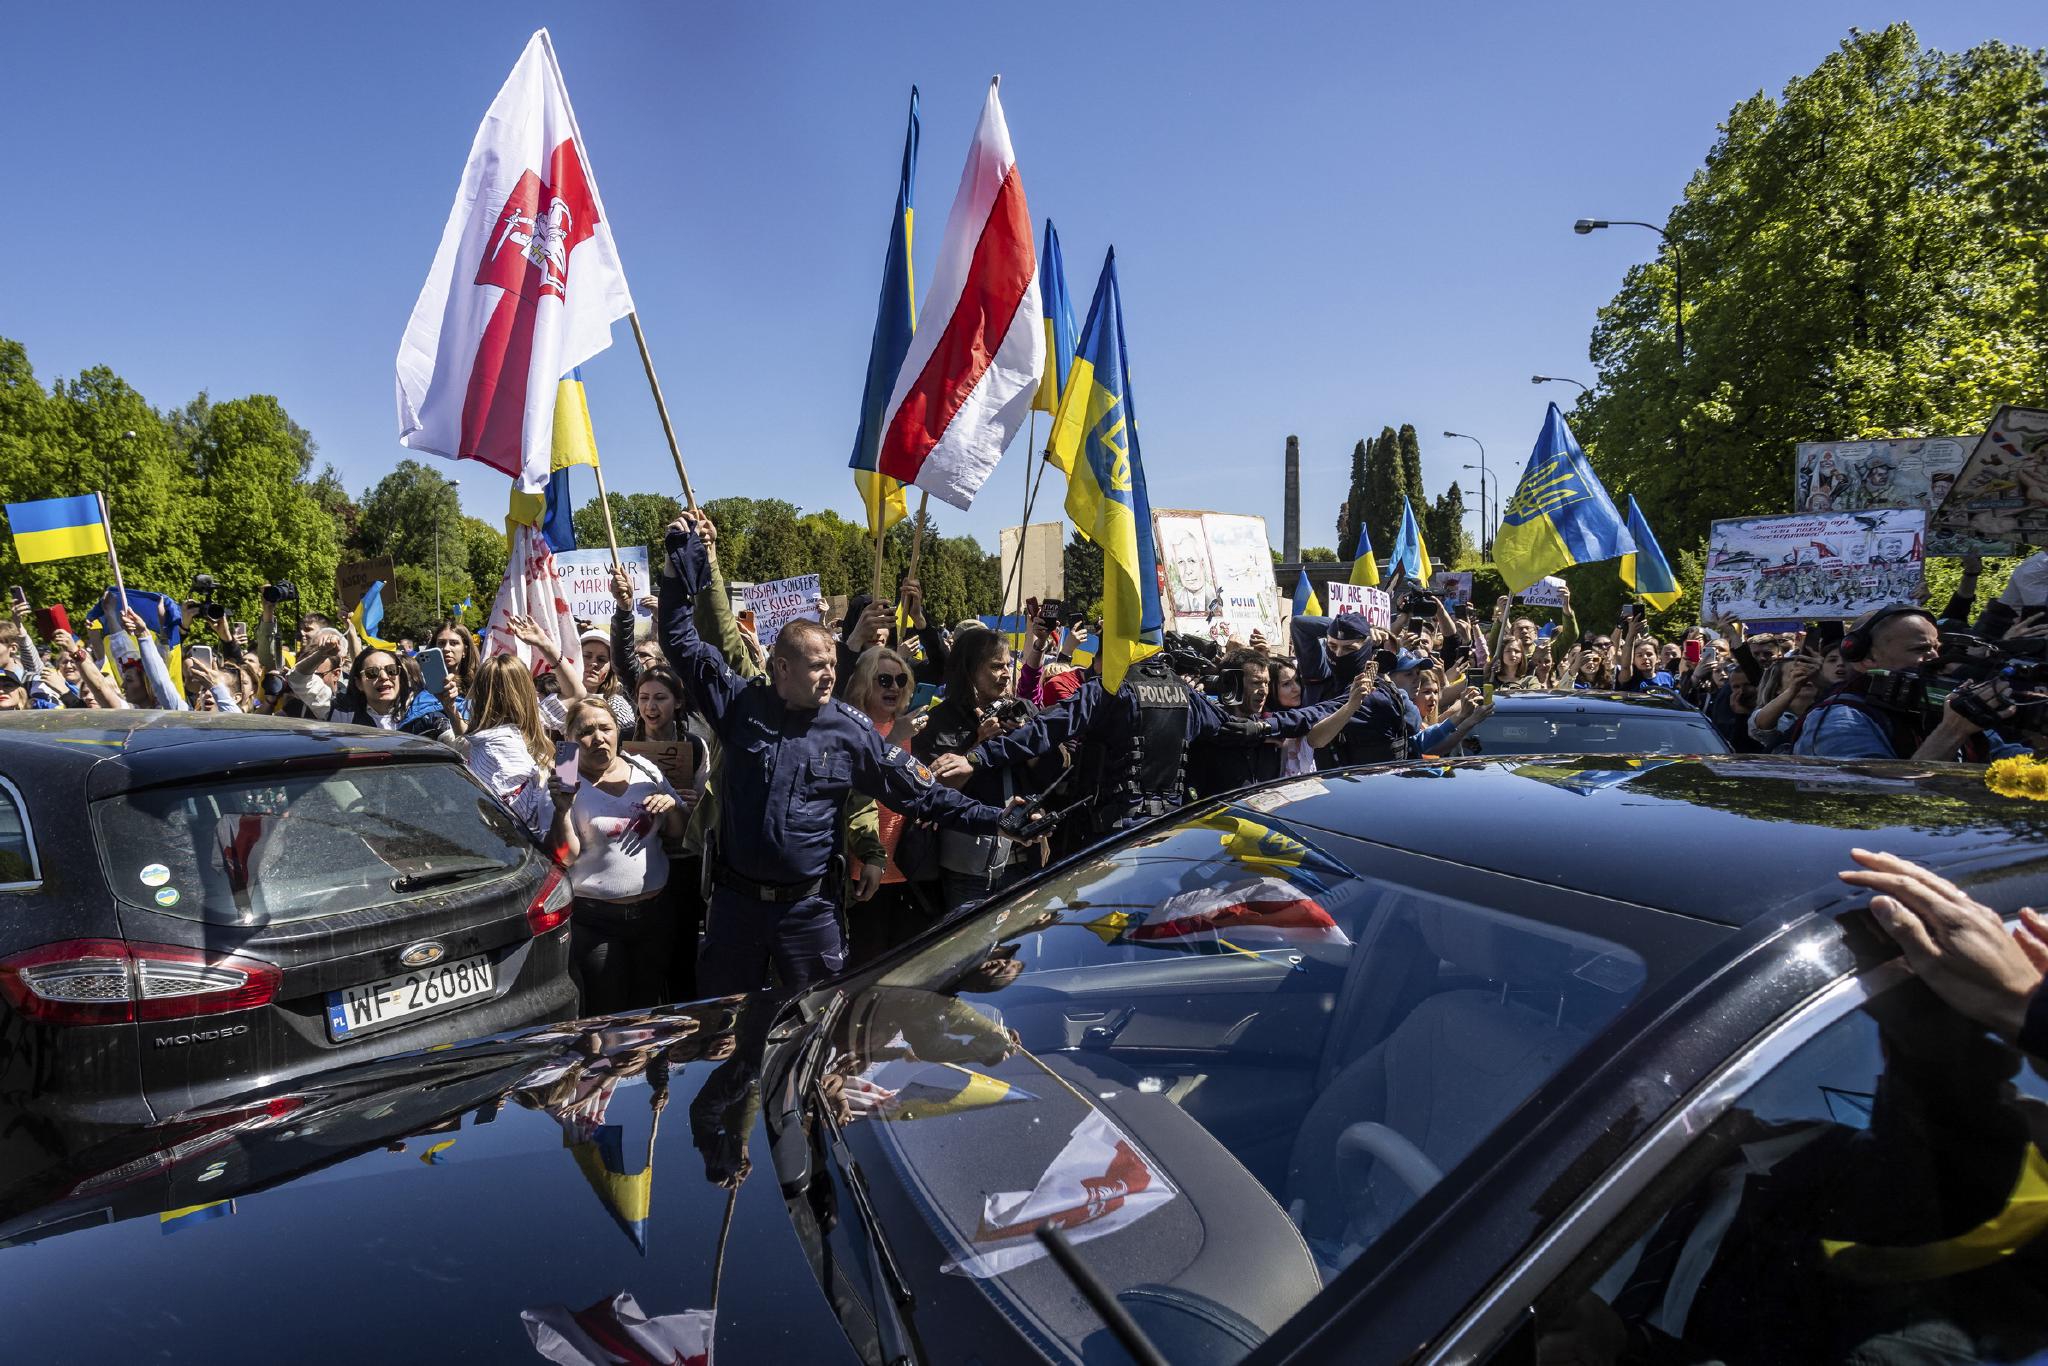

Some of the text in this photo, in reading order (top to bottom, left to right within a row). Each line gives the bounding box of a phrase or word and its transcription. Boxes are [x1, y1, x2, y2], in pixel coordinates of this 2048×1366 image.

[580, 565, 600, 576] the
[743, 575, 820, 600] RUSSIAN SOLDIERS
[1330, 584, 1344, 601] YOU
[1348, 586, 1362, 603] ARE
[769, 593, 802, 610] KILLED
[770, 607, 797, 620] 25000
[1138, 685, 1188, 703] POLICJA
[349, 958, 489, 1025] WF 2608N
[333, 1016, 346, 1028] PL
[155, 1025, 249, 1047] MONDEO
